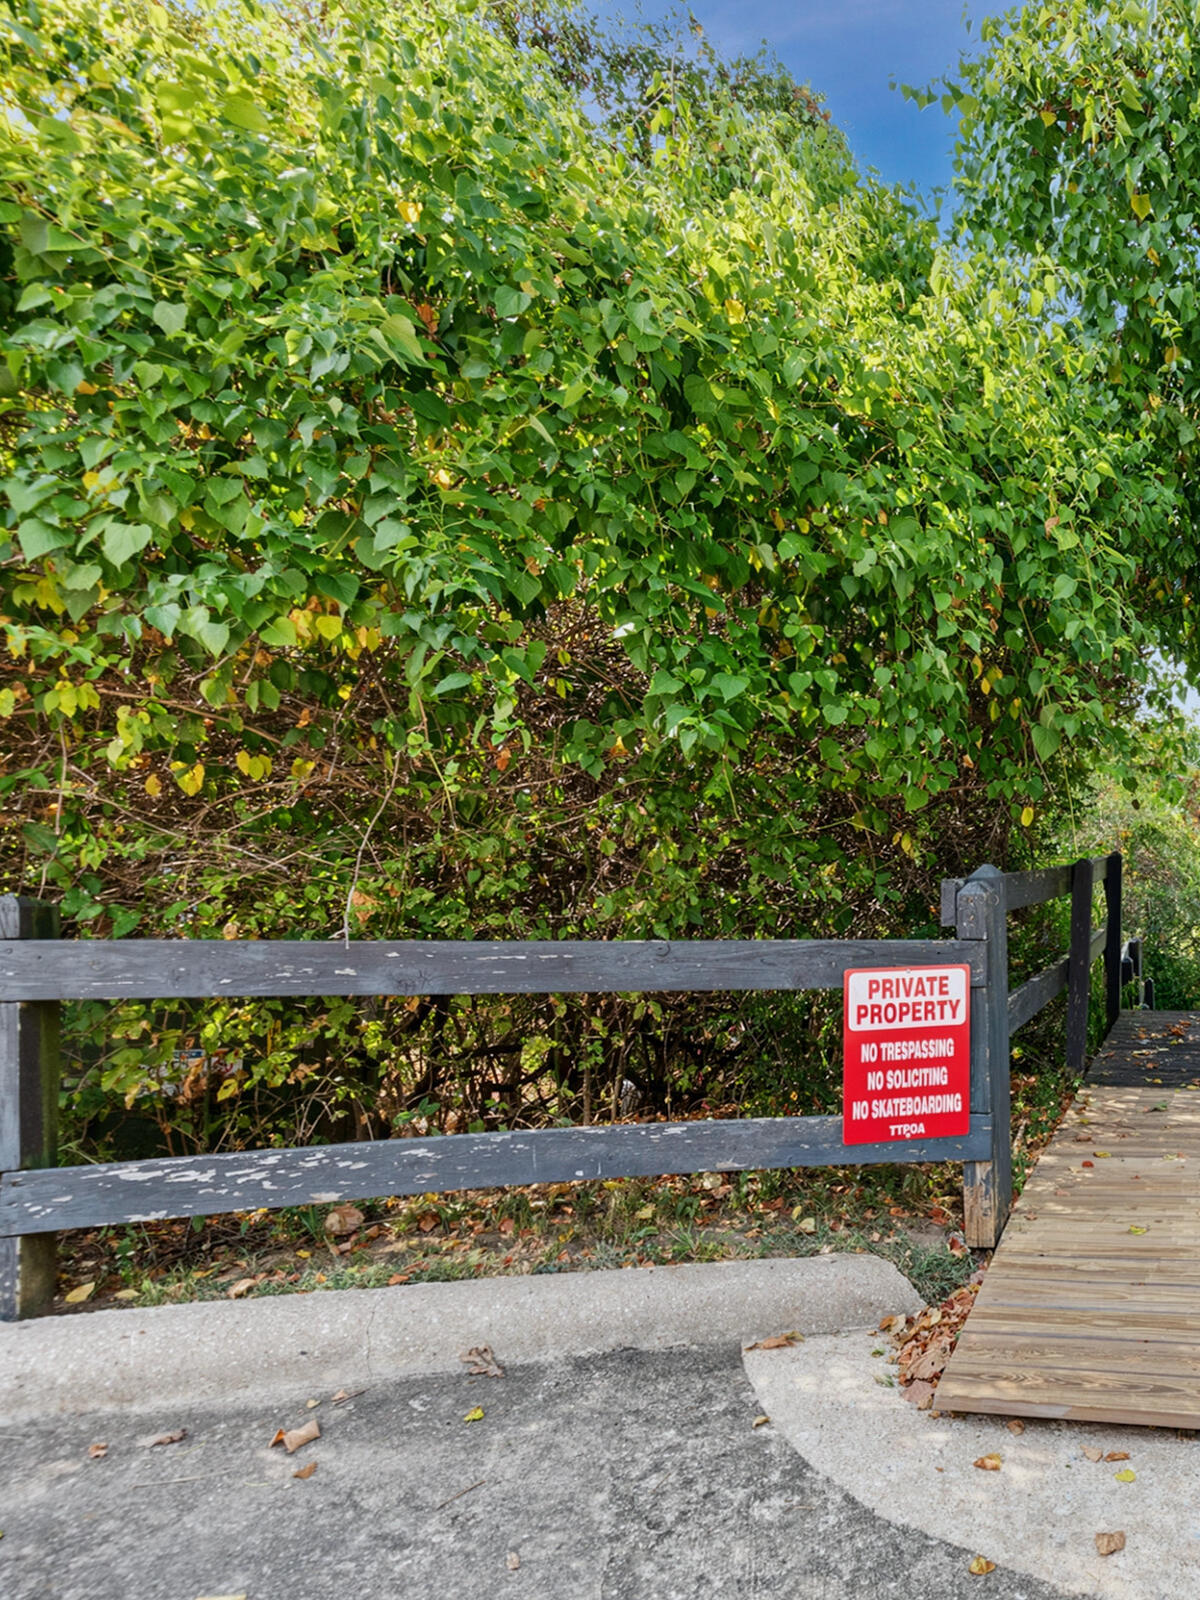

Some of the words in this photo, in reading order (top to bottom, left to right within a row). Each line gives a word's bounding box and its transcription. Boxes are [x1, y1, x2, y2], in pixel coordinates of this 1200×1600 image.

[868, 976, 949, 999] PRIVATE
[856, 999, 961, 1025] PROPERTY
[861, 1043, 878, 1063] NO
[880, 1038, 954, 1061] TRESPASSING
[867, 1072, 884, 1091] NO
[886, 1066, 948, 1089] SOLICITING
[852, 1101, 869, 1120] NO
[871, 1093, 962, 1119] SKATEBOARDING
[889, 1122, 925, 1136] TTPOA
